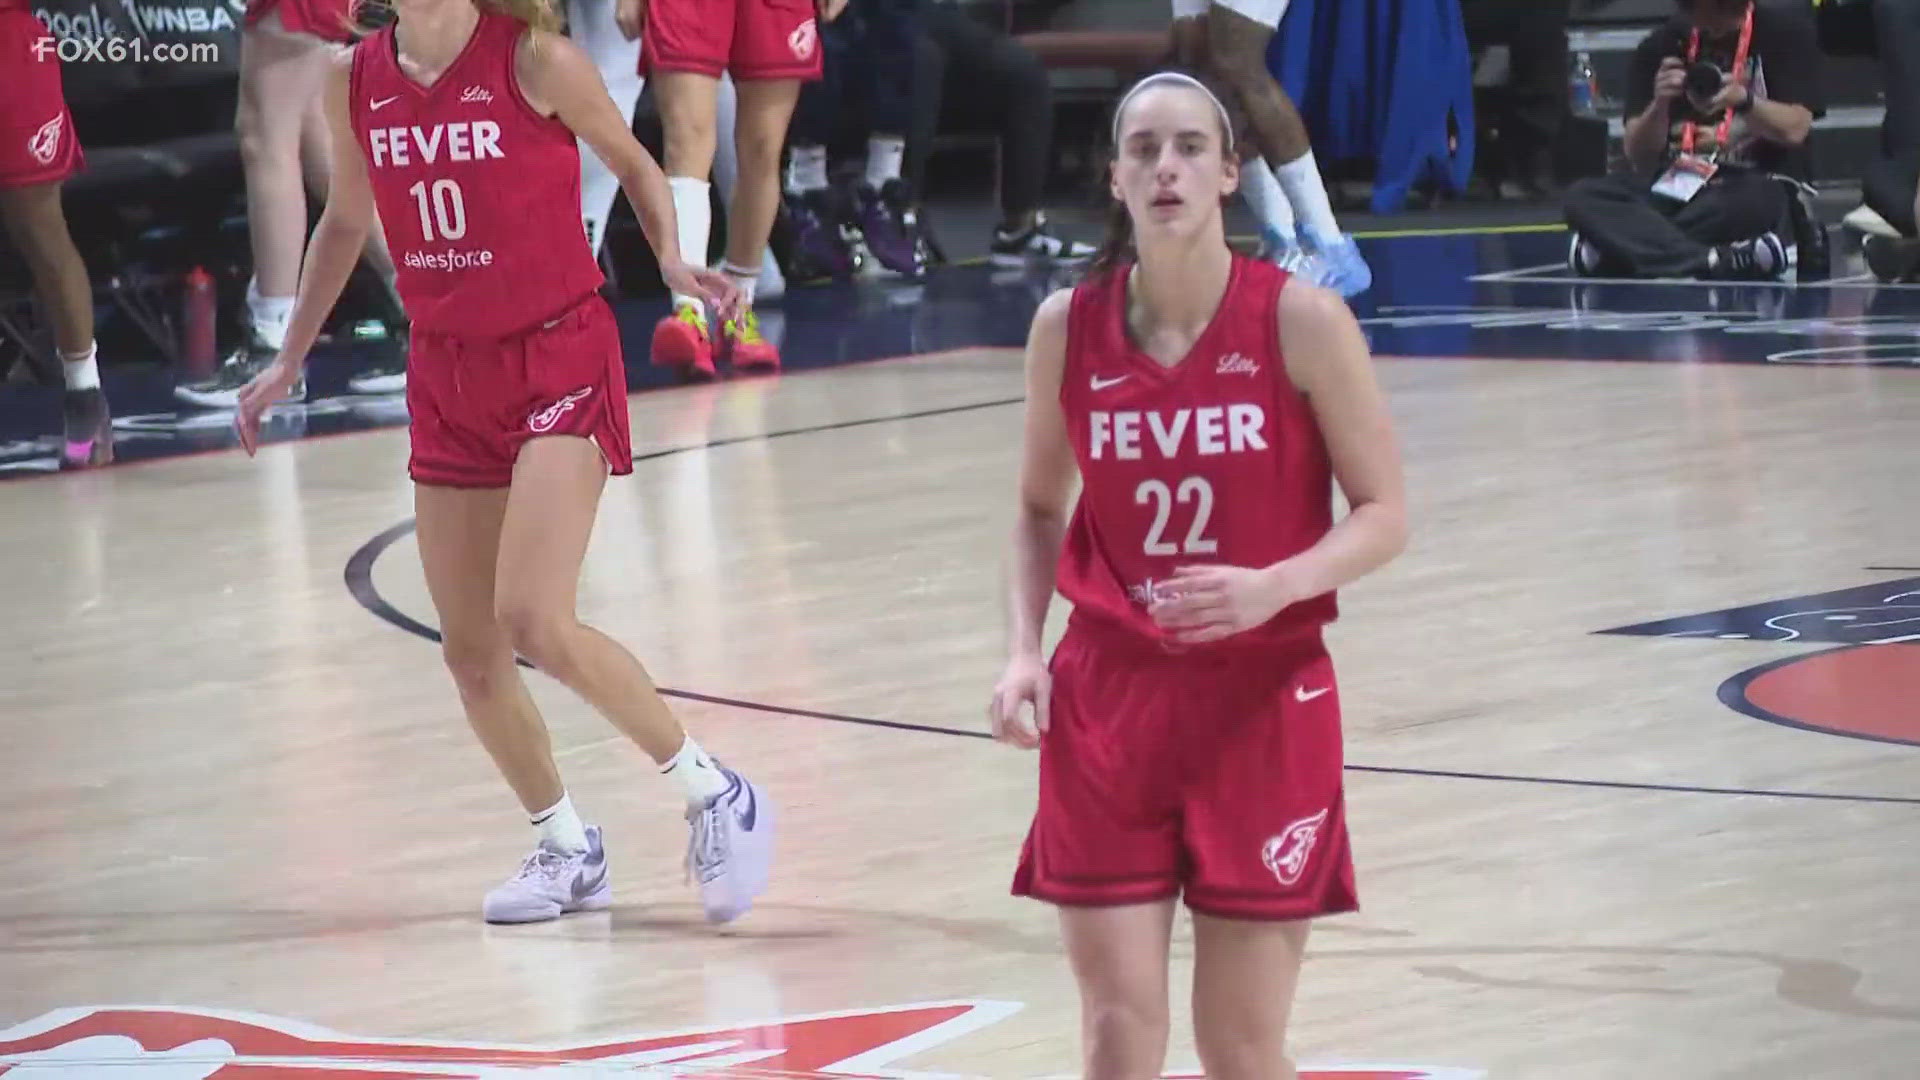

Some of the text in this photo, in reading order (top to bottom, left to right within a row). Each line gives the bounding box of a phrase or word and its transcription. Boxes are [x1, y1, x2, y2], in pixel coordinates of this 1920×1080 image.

[138, 6, 236, 33] WNBA
[460, 85, 494, 106] Lilly
[369, 120, 505, 167] FEVER
[409, 178, 467, 242] 10
[404, 248, 493, 272] salesforce
[1216, 352, 1260, 377] Lilly
[1089, 403, 1269, 461] FEVER
[1135, 476, 1218, 556] 22
